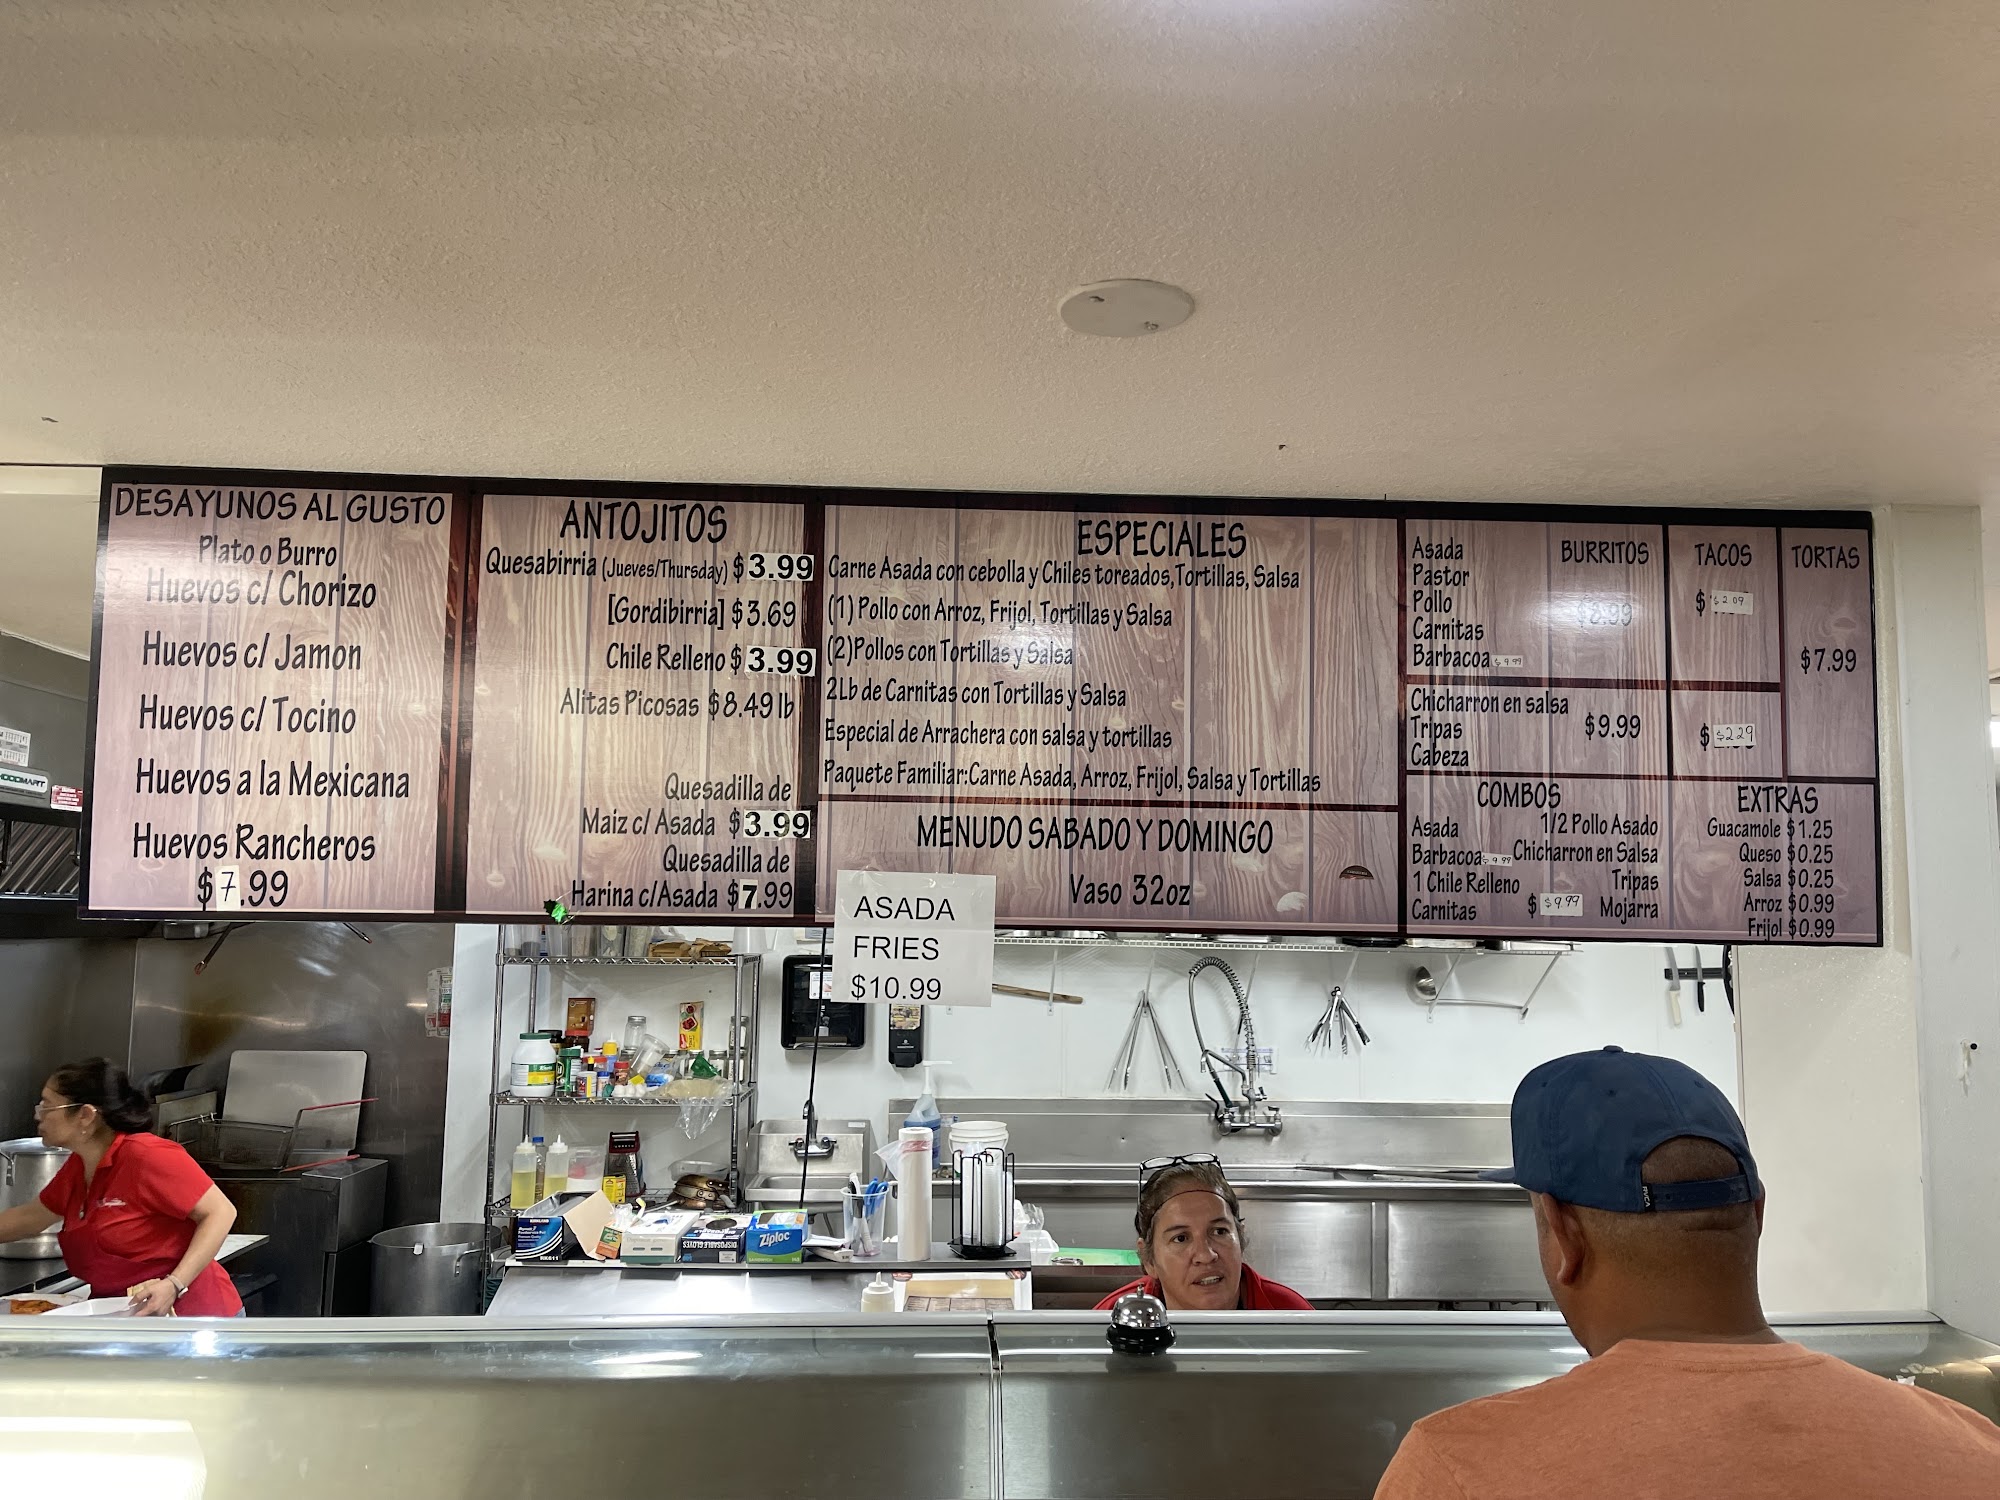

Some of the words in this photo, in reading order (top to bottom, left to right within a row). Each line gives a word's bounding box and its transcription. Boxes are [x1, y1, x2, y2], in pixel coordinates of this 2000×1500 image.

[115, 488, 296, 519] DESAYUNOS
[303, 493, 339, 521] AL
[347, 495, 445, 525] GUSTO
[560, 500, 727, 543] ANTOJITOS
[199, 536, 254, 564] Plato
[260, 546, 271, 564] o
[277, 538, 337, 566] Burro
[1078, 520, 1246, 558] ESPECIALES
[1412, 536, 1463, 559] Asada
[1561, 540, 1649, 564] BURRITOS
[486, 547, 597, 576] Quesabirria
[602, 557, 728, 585] (Jueves/Thursday)
[1694, 543, 1752, 566] TACOS
[1792, 545, 1860, 569] TORTAS
[829, 555, 876, 579] Carne
[880, 556, 931, 581] Asada
[937, 564, 964, 581] con
[969, 559, 1025, 582] cebolla
[1028, 568, 1038, 589] y
[1042, 560, 1090, 584] Chiles
[1254, 565, 1299, 588] Salsa
[1413, 563, 1470, 586] Pastor
[147, 568, 239, 604] Huevos
[247, 569, 272, 605] c/
[279, 570, 376, 608] Chorizo
[1413, 590, 1452, 612] Pollo
[608, 594, 724, 629] [Gordibirria]
[829, 594, 854, 626] (1)
[859, 596, 898, 620] Pollo
[902, 602, 930, 621] con
[934, 598, 985, 626] Arroz,
[990, 600, 1035, 630] Frijol,
[1040, 600, 1110, 625] Tortillas
[1113, 609, 1123, 631] y
[1127, 603, 1172, 626] Salsa
[1413, 616, 1484, 641] Carnitas
[143, 631, 236, 668] Huevos
[244, 633, 269, 669] c/
[275, 634, 361, 670] Jamon
[607, 643, 651, 670] Chile
[657, 645, 725, 671] Relleno
[908, 644, 936, 662] con
[940, 639, 1010, 663] Tortillas
[1014, 647, 1024, 669] y
[1028, 641, 1072, 665] Salsa
[1413, 644, 1490, 668] Barbacoa
[1801, 646, 1856, 674] $7.99
[560, 688, 619, 716] Alitas
[625, 690, 699, 717] Picosas
[779, 693, 794, 719] lb
[827, 677, 857, 701] 2Lb
[861, 678, 881, 700] de
[886, 678, 957, 702] Carnitas
[962, 685, 989, 704] con
[994, 681, 1063, 705] Tortillas
[1067, 690, 1077, 711] y
[1081, 683, 1126, 706] Salsa
[1411, 688, 1499, 713] Chicharron
[1503, 695, 1521, 713] en
[1526, 690, 1569, 714] salsa
[139, 694, 233, 731] Huevos
[241, 696, 266, 732] c/
[273, 697, 356, 733] Tocino
[1585, 712, 1641, 740] $9.99
[825, 718, 894, 751] Especial
[898, 720, 917, 742] de
[922, 720, 1005, 744] Arrachera
[1010, 727, 1037, 745] con
[1042, 723, 1085, 746] salsa
[1088, 730, 1099, 752] y
[1103, 725, 1172, 748] tortillas
[1411, 715, 1462, 747] Tripas
[1411, 742, 1469, 767] Cabeza
[136, 758, 230, 795] Huevos
[237, 770, 250, 795] a
[260, 760, 280, 796] la
[289, 761, 409, 798] Mexicana
[665, 772, 763, 801] Quesadilla
[769, 775, 791, 801] de
[825, 759, 892, 792] Paquete
[1020, 762, 1077, 790] Asada,
[1081, 764, 1131, 791] Arroz,
[1137, 765, 1183, 796] Frijol,
[1188, 766, 1233, 790] Salsa
[1237, 774, 1247, 796] y
[1250, 767, 1321, 792] Tortillas
[1478, 781, 1561, 808] COMBOS
[1738, 786, 1818, 814] EXTRAS
[583, 808, 627, 835] Maiz
[632, 808, 651, 835] c/
[655, 809, 715, 836] Asada
[918, 815, 1022, 849] MENUDO
[1029, 817, 1130, 851] SABADO
[1137, 819, 1152, 851] Y
[1159, 818, 1273, 853] DOMINGO
[1412, 815, 1458, 837] Asada
[1540, 813, 1567, 834] 1/2
[1572, 813, 1607, 834] Pollo
[1611, 814, 1658, 836] Asado
[1707, 817, 1781, 838] Guacamole
[1787, 818, 1833, 840] $1.25
[133, 822, 227, 860] Huevos
[235, 824, 375, 861] Rancheros
[1412, 844, 1482, 866] Barbacoa
[1514, 839, 1592, 862] Chicharron
[1597, 846, 1613, 862] en
[1617, 842, 1658, 863] Salsa
[1739, 842, 1781, 863] Queso
[1787, 843, 1833, 865] $0.25
[663, 844, 762, 873] Quesadilla
[767, 848, 790, 873] de
[198, 867, 288, 911] $7.99
[1070, 874, 1122, 904] Vaso
[1132, 874, 1190, 906] 32oz
[1413, 871, 1420, 892] 1
[1427, 872, 1462, 893] Chile
[1467, 872, 1520, 894] Relleno
[1612, 869, 1659, 898] Tripas
[1744, 868, 1781, 887] Salsa
[1788, 868, 1834, 890] $0.25
[572, 880, 634, 907] Harina
[1744, 892, 1782, 913] Arroz
[1788, 893, 1834, 914] $0.99
[854, 896, 955, 921] ASADA
[1412, 899, 1477, 921] Carnitas
[1600, 896, 1658, 924] Mojarra
[1748, 918, 1782, 942] Frijol
[1788, 918, 1835, 940] $0.99
[853, 936, 939, 960] FRIES
[851, 974, 941, 1000] $10.99
[759, 1232, 790, 1247] Ziploc
